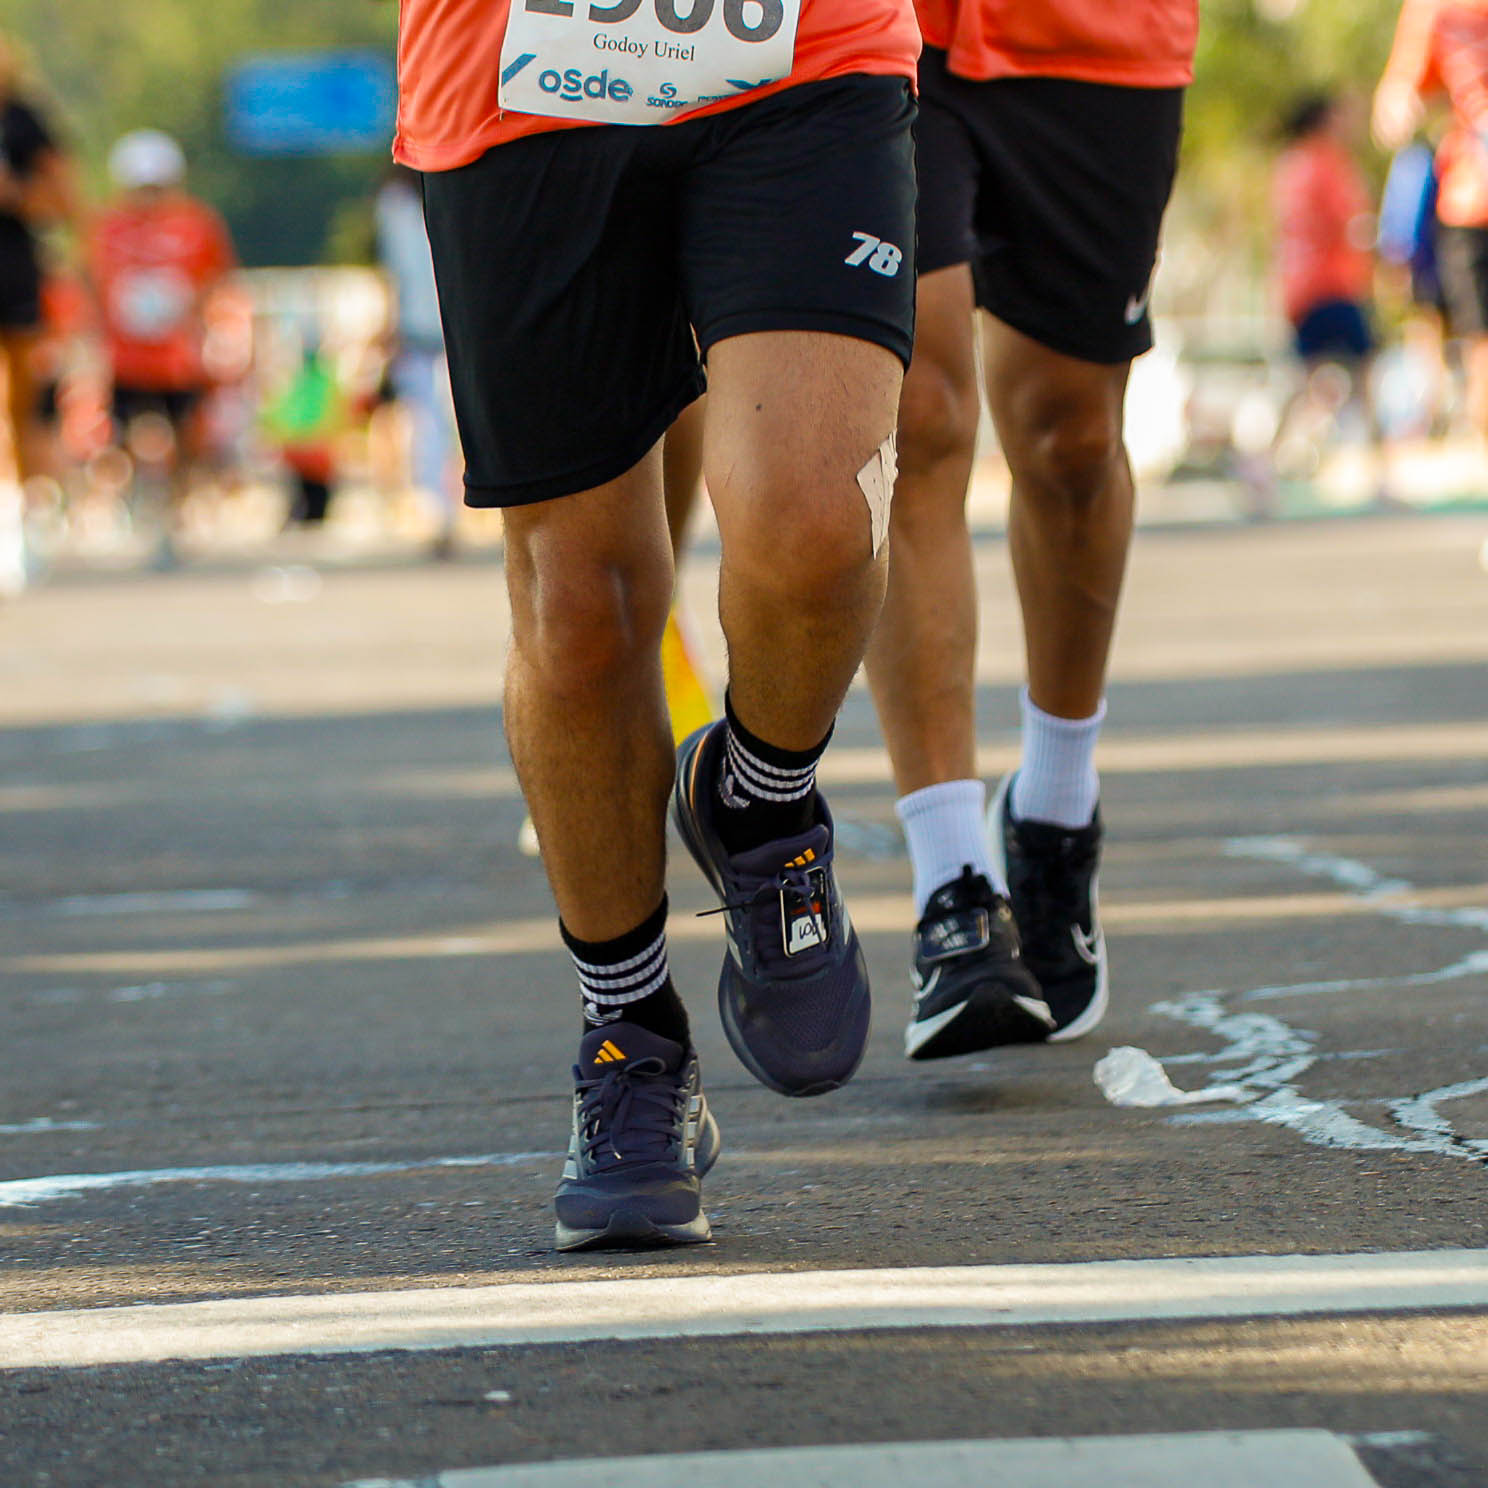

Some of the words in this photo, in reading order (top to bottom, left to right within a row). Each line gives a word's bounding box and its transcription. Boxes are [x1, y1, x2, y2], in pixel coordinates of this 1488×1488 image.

[593, 32, 649, 59] Godoy
[654, 40, 695, 62] Uriel
[538, 68, 633, 101] osde
[844, 231, 903, 278] 78
